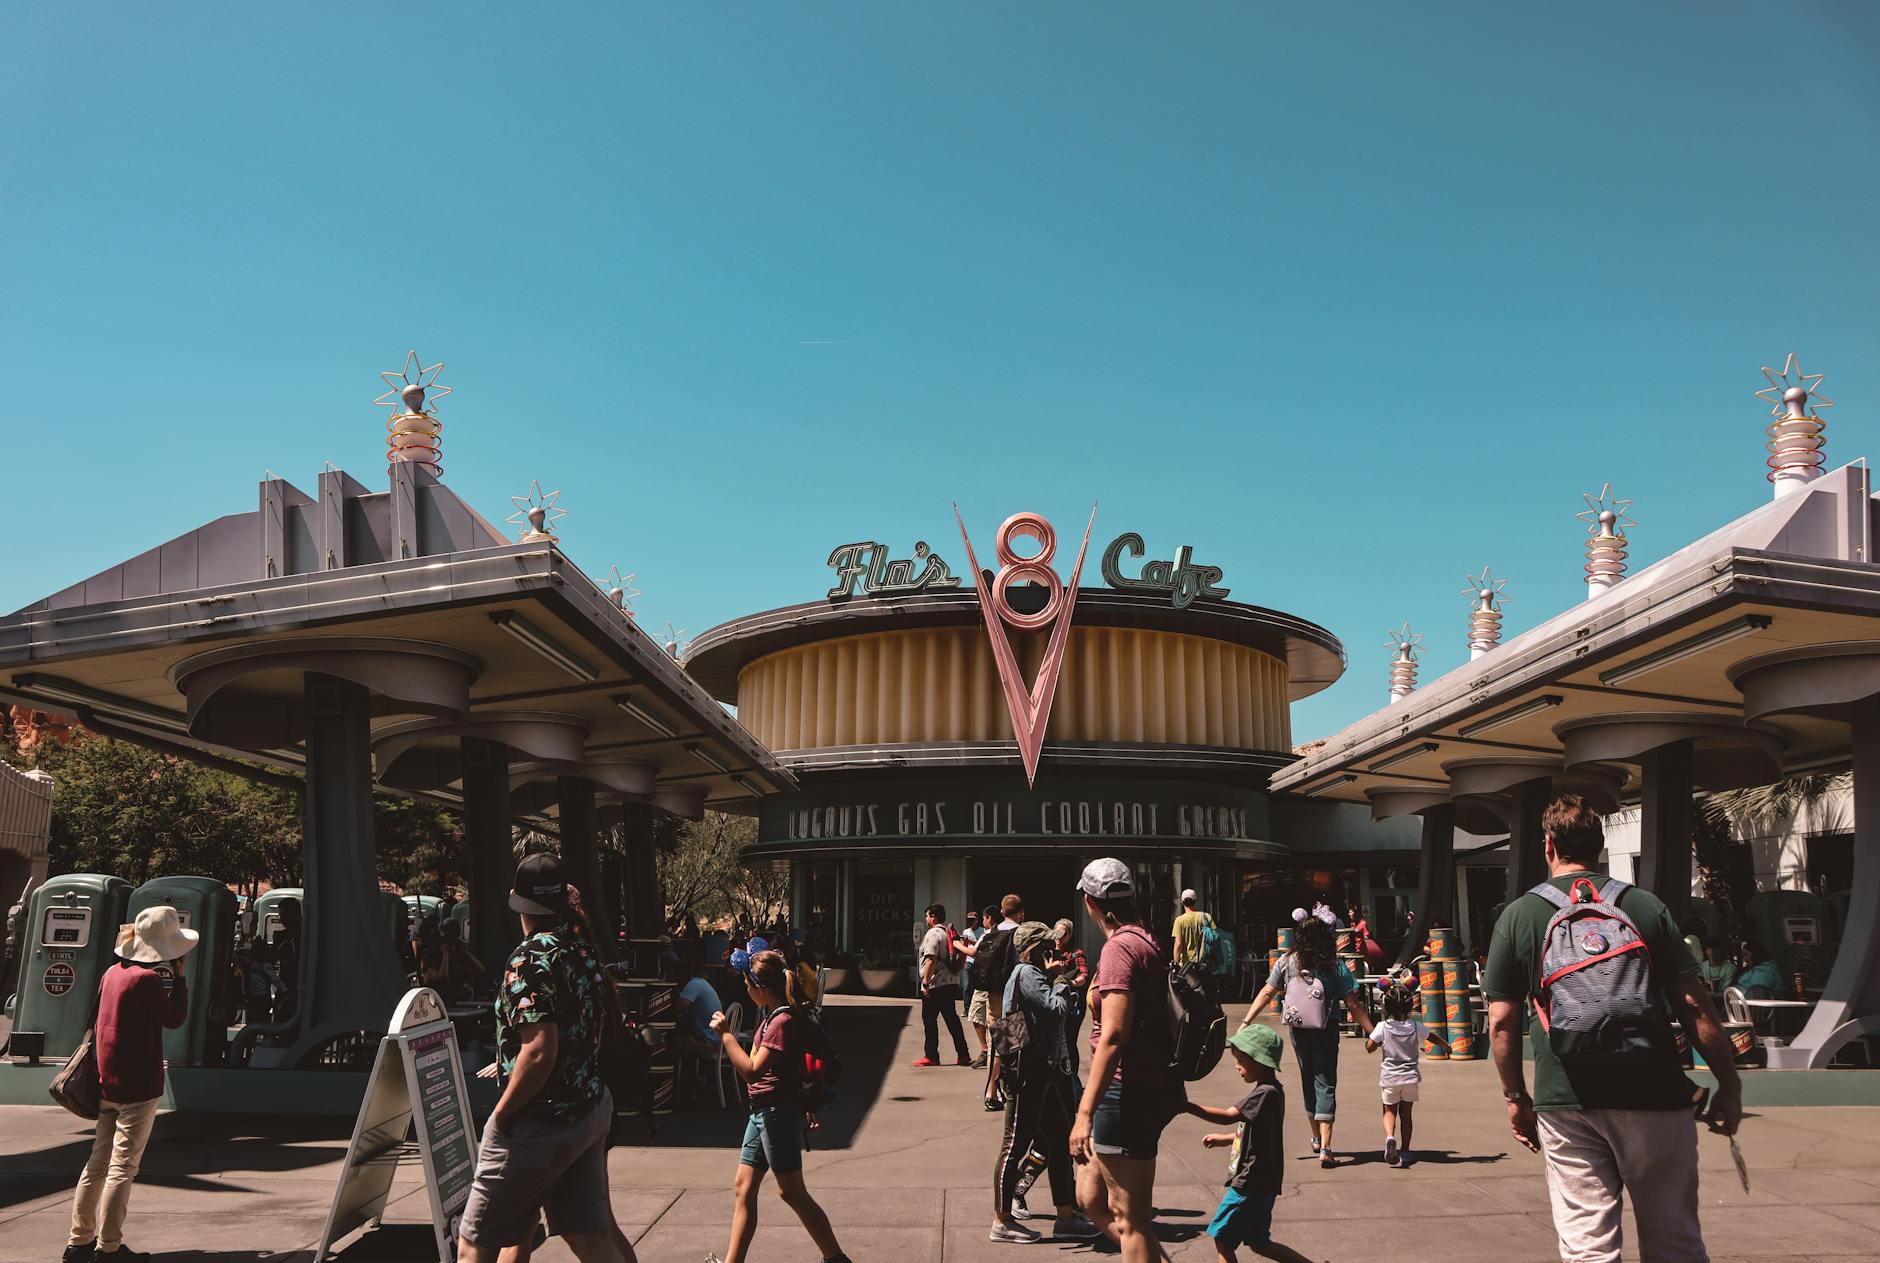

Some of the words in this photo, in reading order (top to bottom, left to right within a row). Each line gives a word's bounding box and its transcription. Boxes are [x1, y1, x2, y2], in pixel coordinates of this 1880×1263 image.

[827, 541, 963, 598] Flo's
[1101, 532, 1231, 609] Cafe
[789, 804, 878, 840] LUGNUTS
[899, 802, 946, 835] GAS
[973, 801, 1016, 834] OIL
[1041, 801, 1158, 835] COOLANT
[1179, 804, 1248, 838] GREASE
[871, 893, 896, 904] DIP
[856, 909, 912, 921] STICKS
